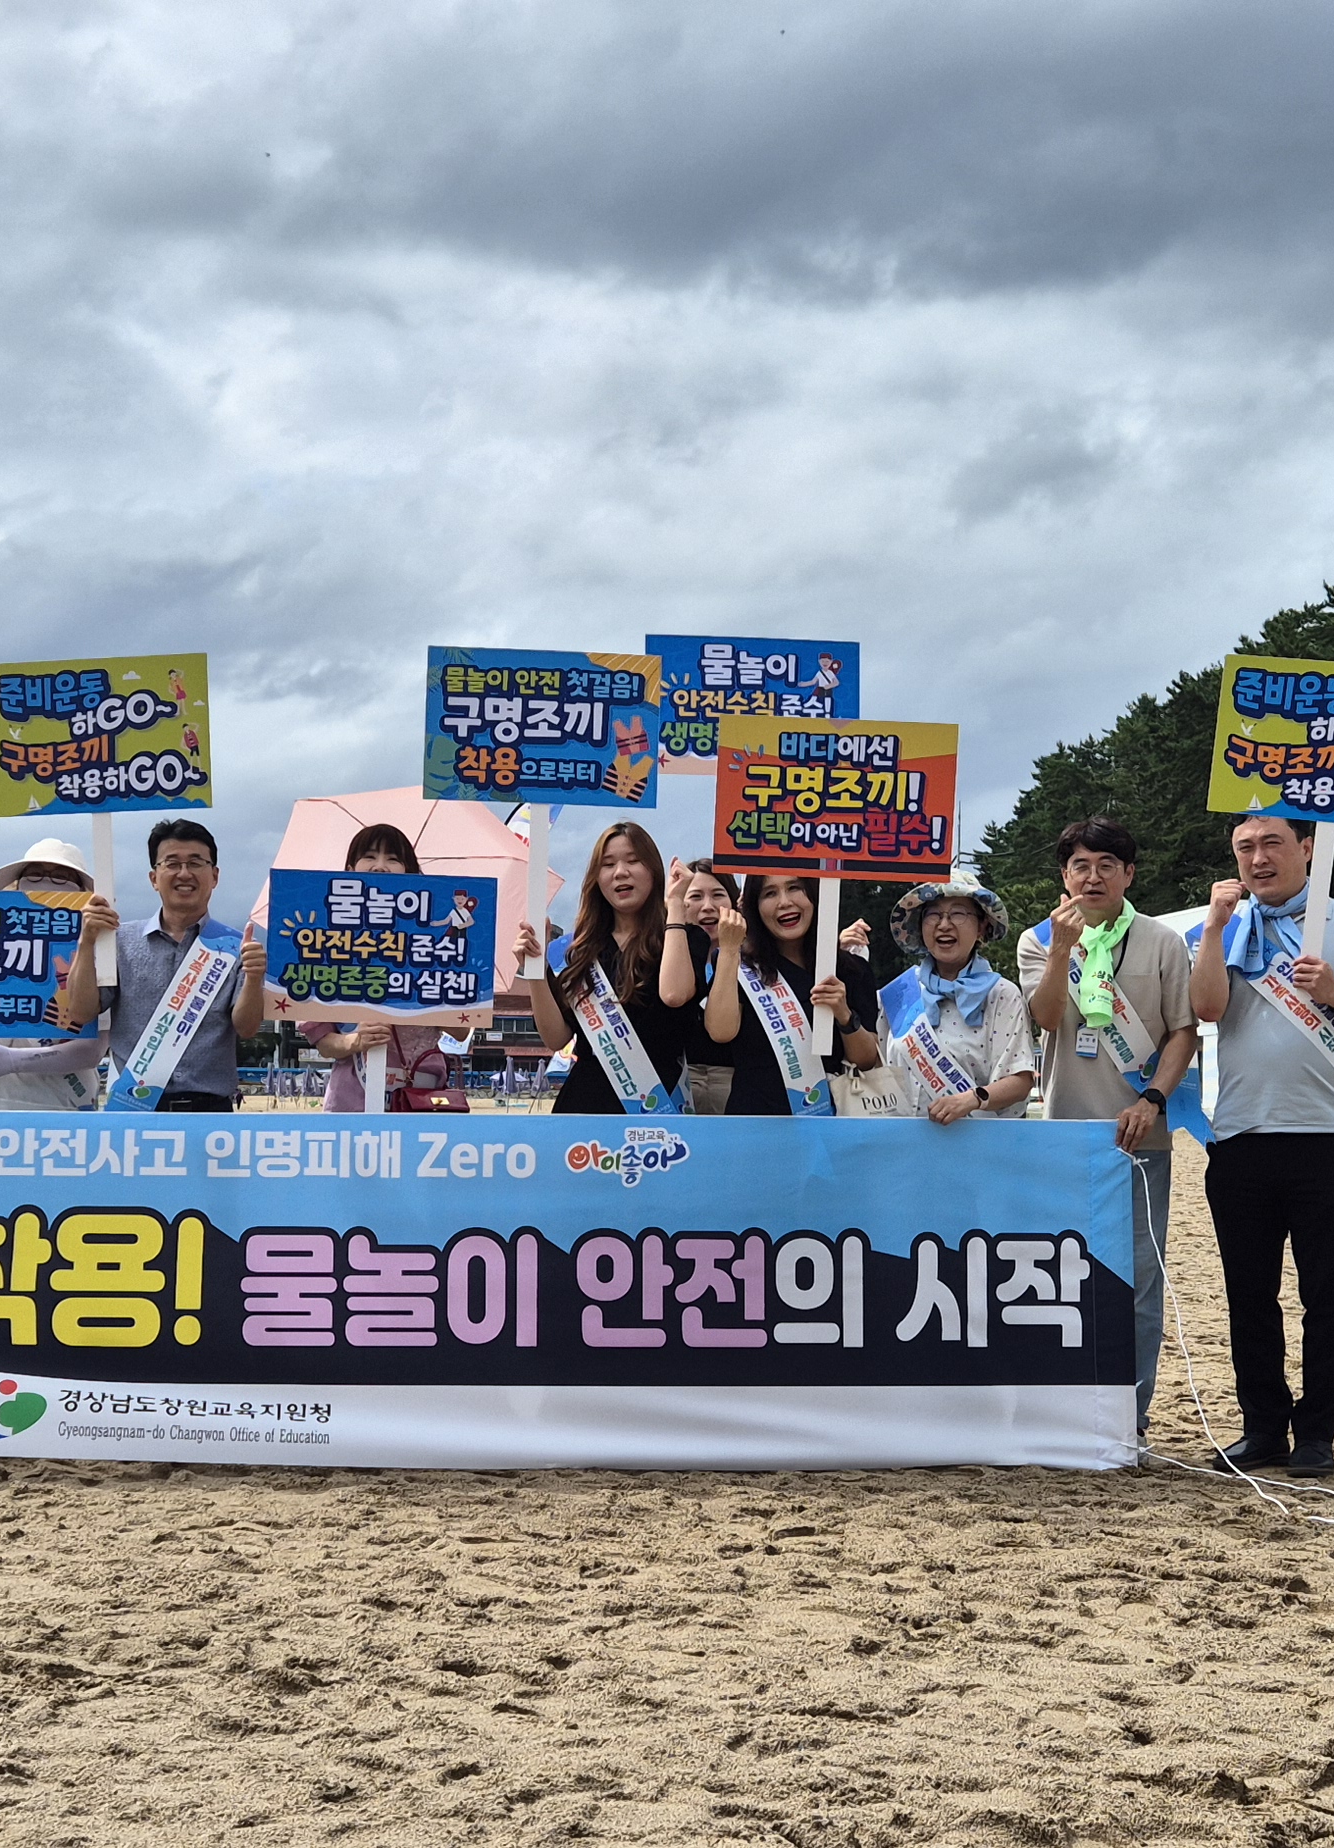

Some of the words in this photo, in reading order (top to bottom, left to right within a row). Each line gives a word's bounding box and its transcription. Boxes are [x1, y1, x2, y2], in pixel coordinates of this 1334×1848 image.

[445, 667, 508, 693] 물놀이
[515, 670, 561, 695] 안전
[567, 671, 642, 699] 첫걸음!
[701, 644, 797, 686] 물놀이
[444, 696, 604, 743] 구명조끼
[673, 690, 775, 717] 안전수칙
[781, 694, 832, 719] 준수!
[1, 734, 109, 776] 구명조끼
[458, 746, 596, 786] 착용으로부터
[780, 732, 895, 767] 바다에선
[744, 766, 921, 813] 구명조끼!
[728, 811, 811, 846] 선택이
[816, 823, 858, 847] 아닌
[865, 813, 943, 851] 필수!
[6, 909, 78, 936] 첫걸음!
[328, 879, 430, 925] 물놀이
[296, 928, 405, 962] 안전수칙
[410, 934, 465, 962] 준수!
[167, 948, 211, 1012] 가족사랑의
[283, 964, 411, 998] 생명존중의
[417, 970, 476, 999] 실천!
[1261, 974, 1322, 1031] 가족사랑의
[133, 1011, 176, 1076] 시작입니다
[597, 1030, 638, 1097] 시작입니다
[902, 1035, 946, 1094] 가족사랑의
[861, 1093, 898, 1111] POLO
[204, 1130, 402, 1179] 인명피해
[417, 1133, 536, 1179] Zero
[627, 1130, 666, 1141] 경남교육
[240, 1233, 539, 1348] 물놀이
[576, 1234, 864, 1349] 안전의
[896, 1236, 1091, 1348] 시작
[58, 1421, 165, 1442] Gyeongsangnam-do
[169, 1424, 225, 1444] Changwon
[229, 1427, 260, 1443] Office
[265, 1428, 275, 1443] of
[279, 1428, 330, 1445] Education
